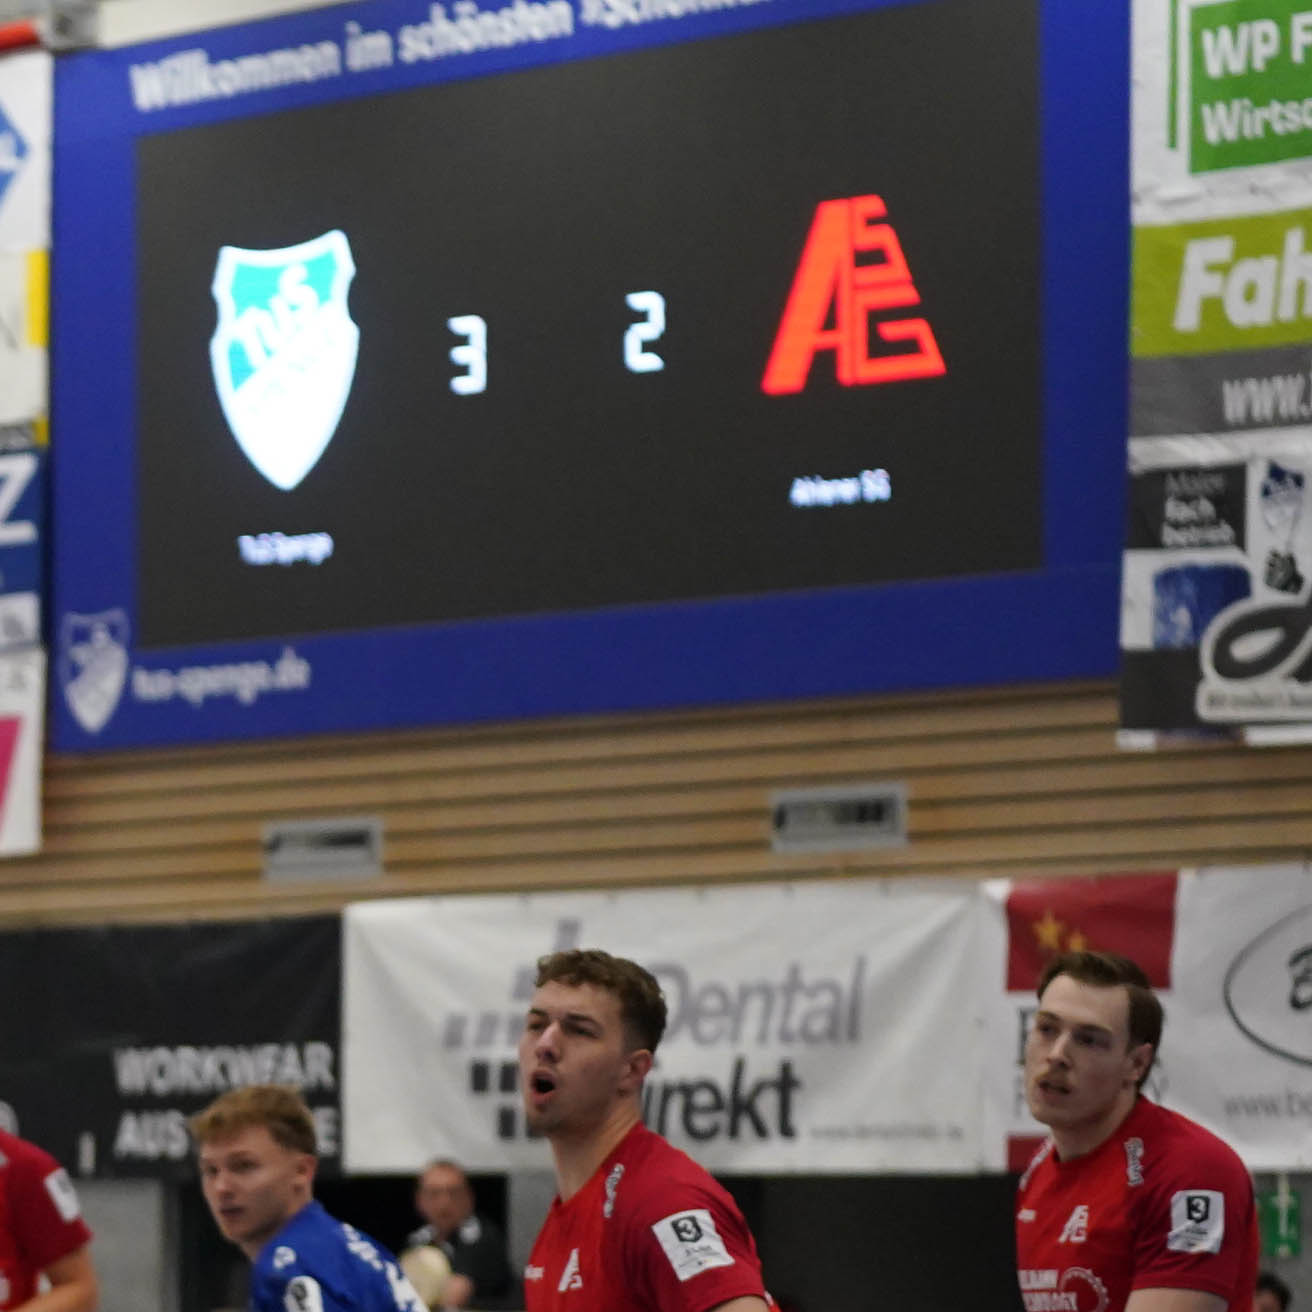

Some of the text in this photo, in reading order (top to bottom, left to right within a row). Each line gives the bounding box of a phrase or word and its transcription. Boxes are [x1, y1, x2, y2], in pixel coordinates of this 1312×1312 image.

[130, 39, 342, 111] Willkommen
[345, 22, 392, 71] im
[399, 0, 573, 64] schönsten
[1200, 19, 1280, 78] WP
[447, 314, 485, 395] 3
[623, 290, 666, 373] 2
[1222, 374, 1312, 424] www.
[114, 1041, 336, 1095] WORKWEAR
[640, 1055, 800, 1145] irekt
